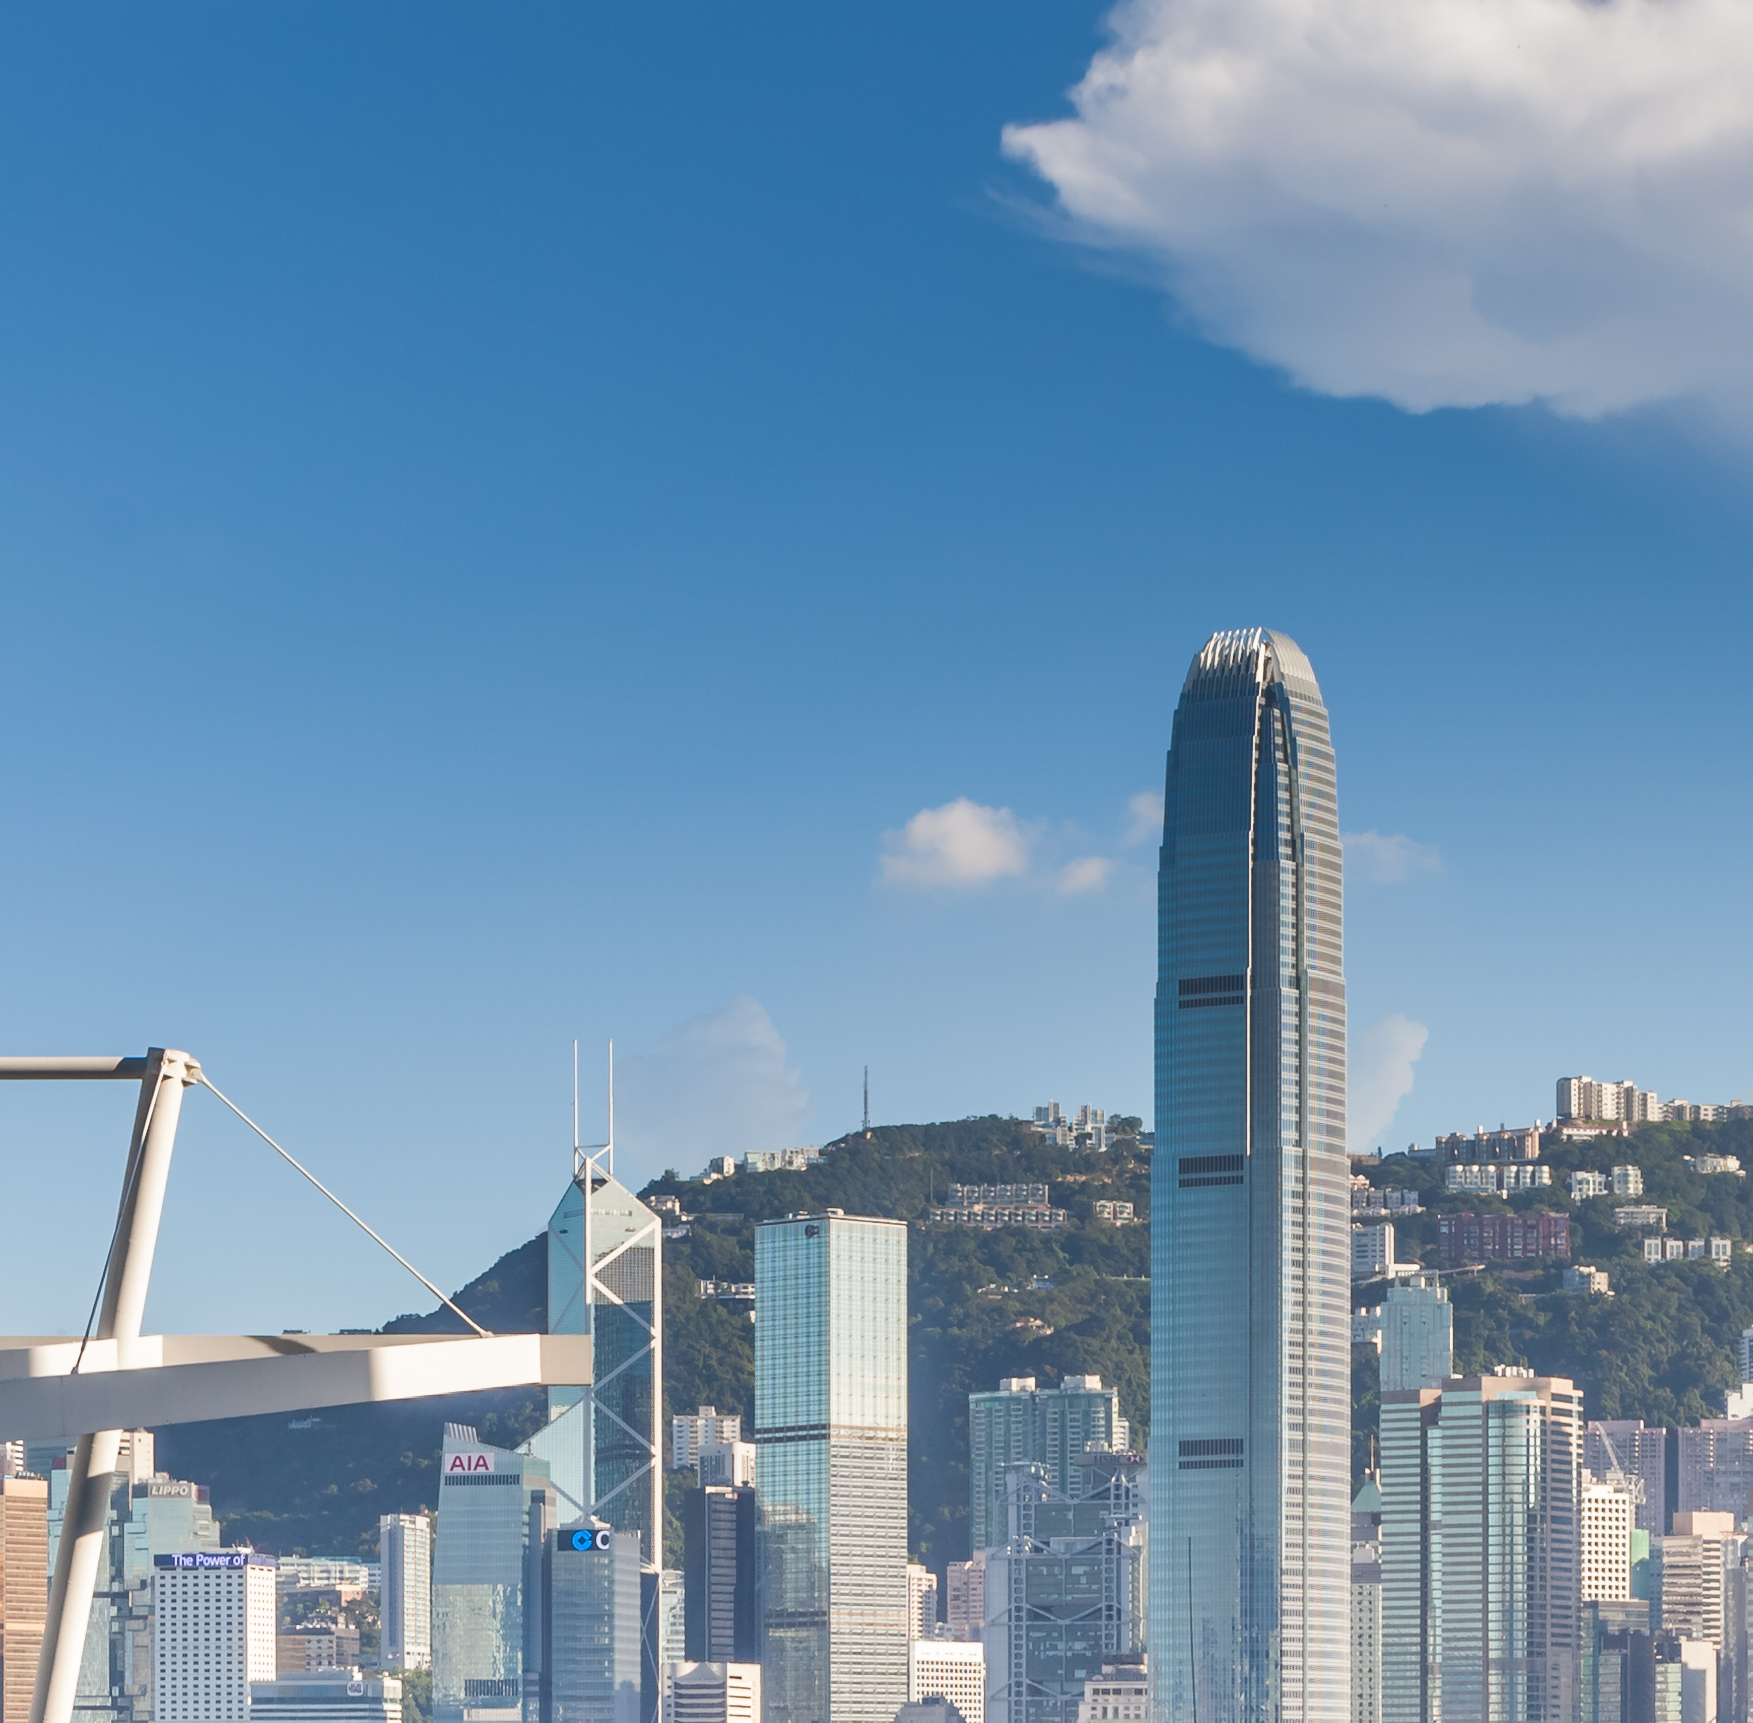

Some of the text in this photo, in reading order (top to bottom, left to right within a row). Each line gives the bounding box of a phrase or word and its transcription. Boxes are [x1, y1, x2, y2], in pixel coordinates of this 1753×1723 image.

[449, 1455, 489, 1471] AIA
[151, 1485, 189, 1496] LIPPO
[172, 1553, 246, 1567] The Power of
